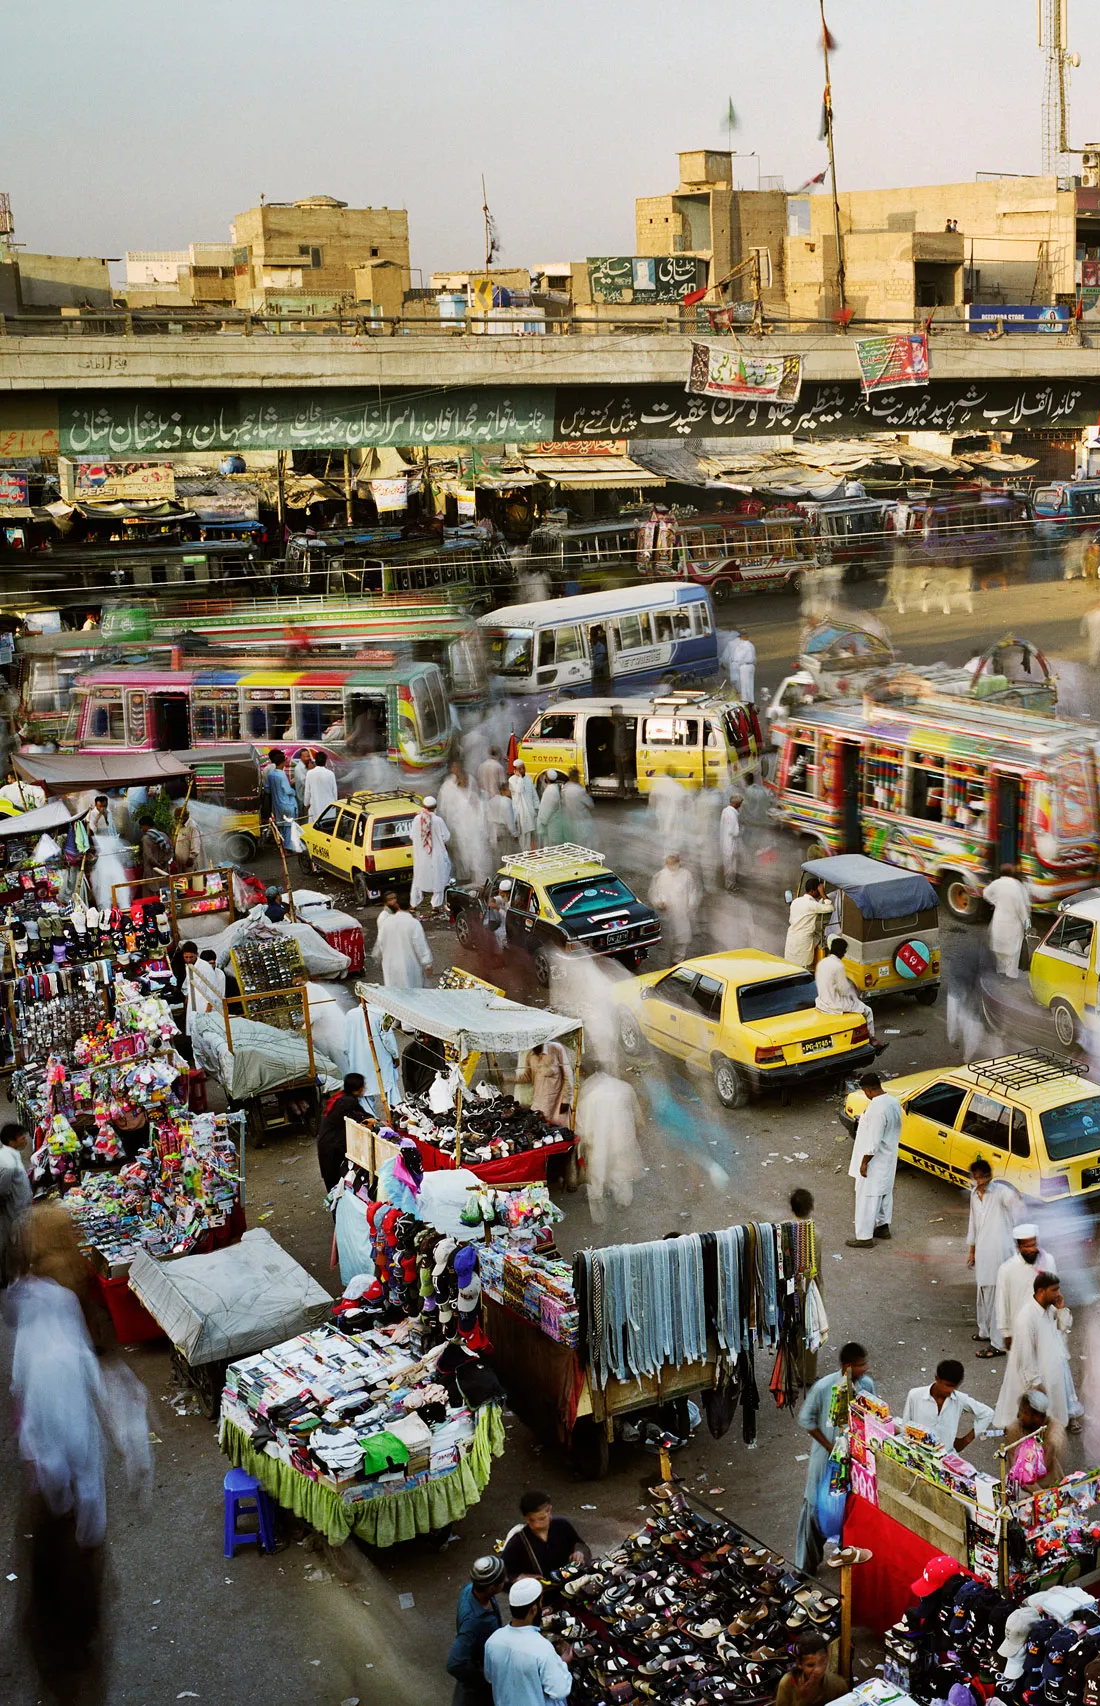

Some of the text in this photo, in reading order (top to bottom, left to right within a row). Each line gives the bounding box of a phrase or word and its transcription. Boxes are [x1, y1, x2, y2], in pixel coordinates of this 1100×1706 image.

[80, 487, 117, 496] PEPSI
[532, 755, 564, 763] TOYOTA
[911, 1155, 969, 1187] KHYBE
